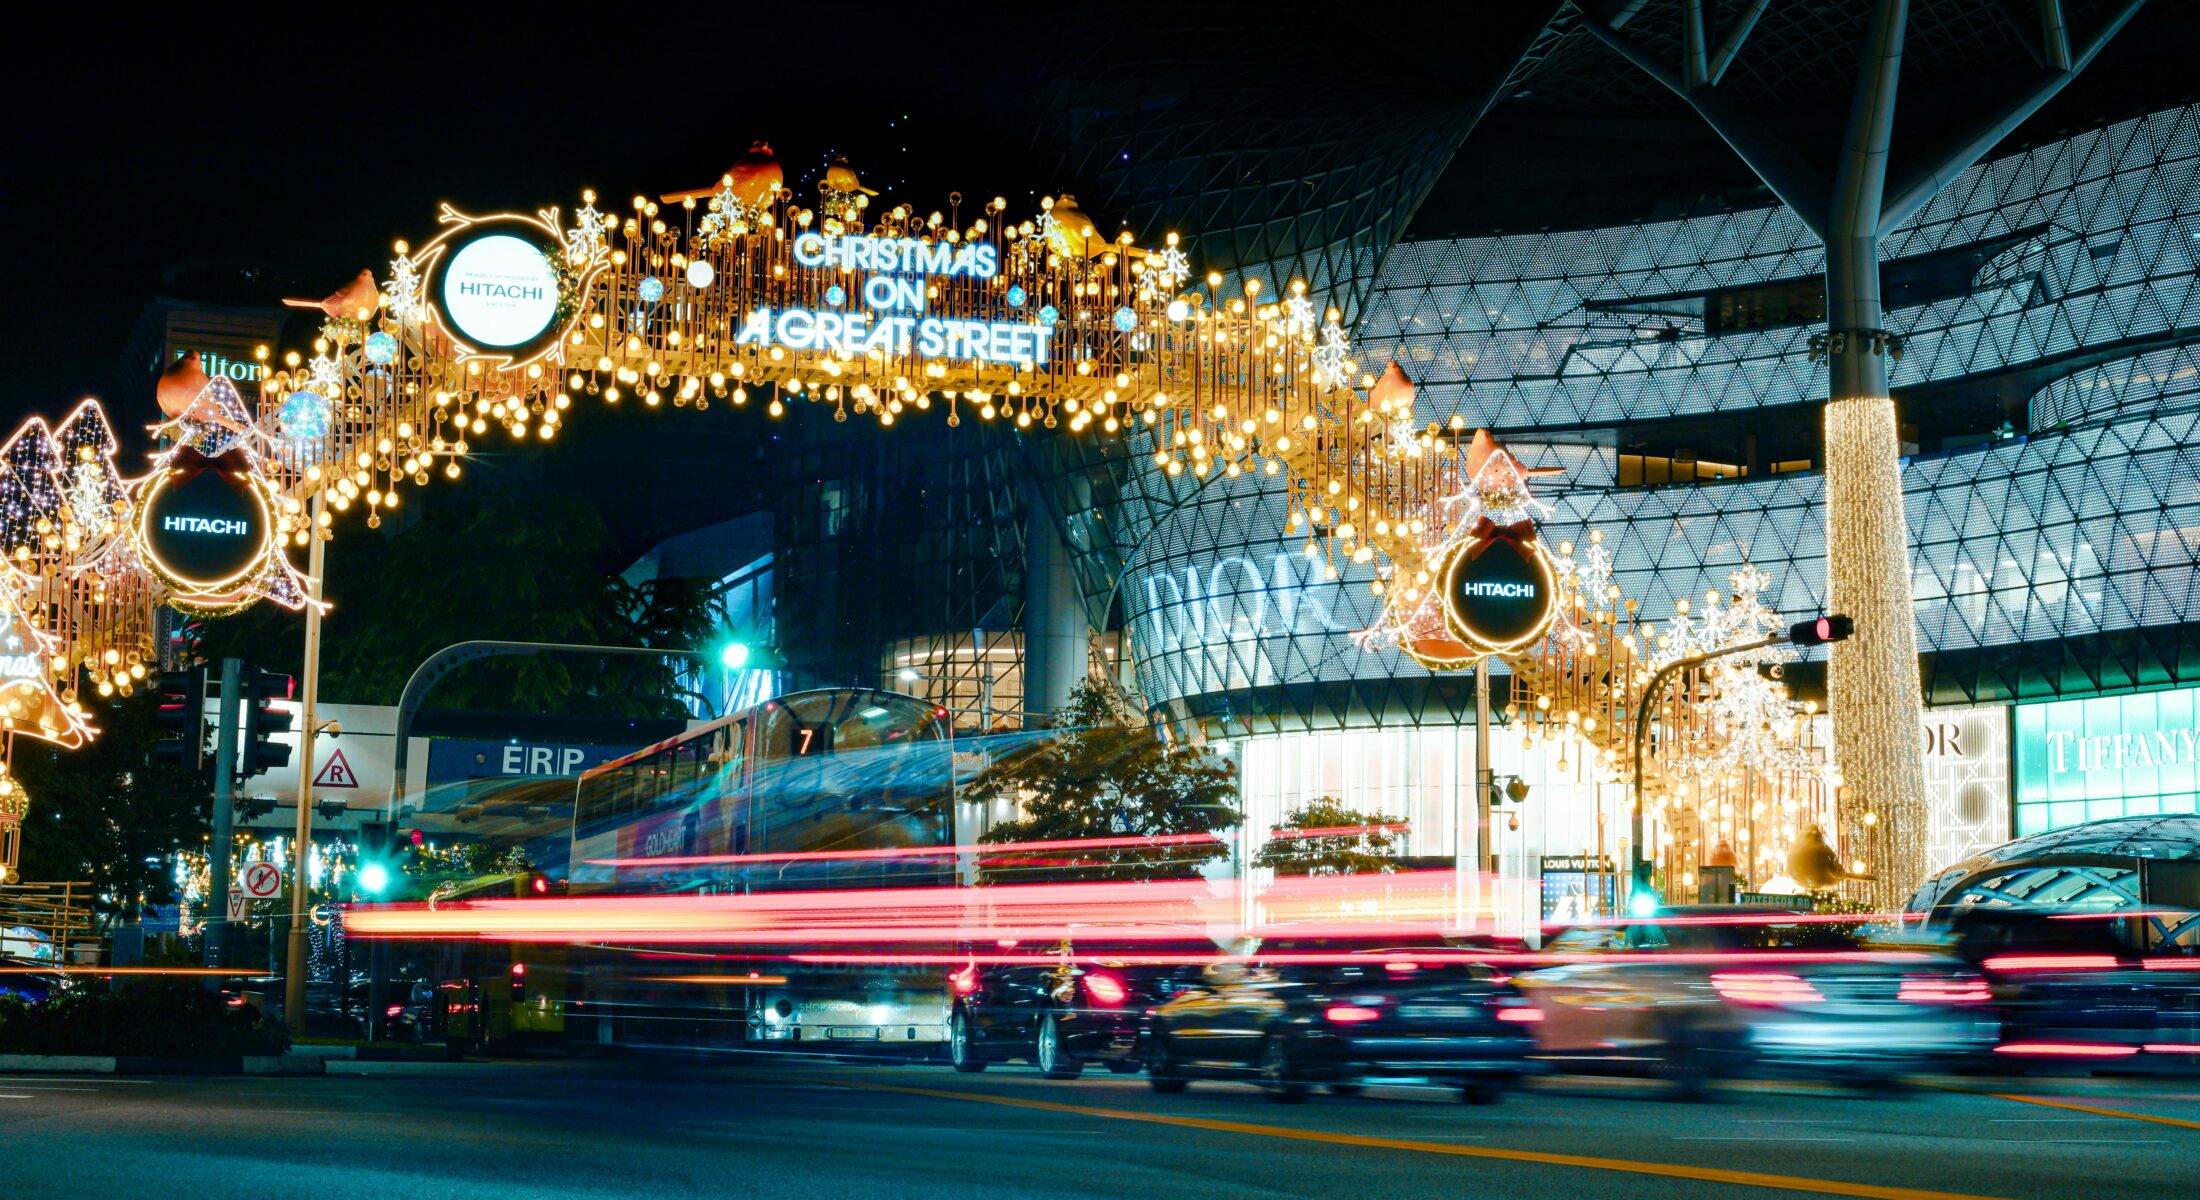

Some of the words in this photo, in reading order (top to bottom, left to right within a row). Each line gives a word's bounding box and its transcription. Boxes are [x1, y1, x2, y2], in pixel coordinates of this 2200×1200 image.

[794, 232, 996, 278] CHRISTMAS
[460, 281, 543, 301] HITACHI
[864, 275, 926, 312] ON
[735, 307, 771, 346] A
[776, 309, 917, 353] GREAT
[919, 317, 1053, 364] STREET
[176, 350, 262, 382] ilton
[164, 516, 247, 535] HITACHI
[1464, 582, 1534, 598] HITACHI
[800, 728, 813, 755] 7
[2046, 727, 2200, 774] TIFFANY
[329, 764, 344, 783] R
[645, 826, 687, 857] GOLDHEART
[1543, 859, 1570, 869] LOUIS
[1743, 894, 1794, 908] PATERSON
[1797, 897, 1811, 909] RD
